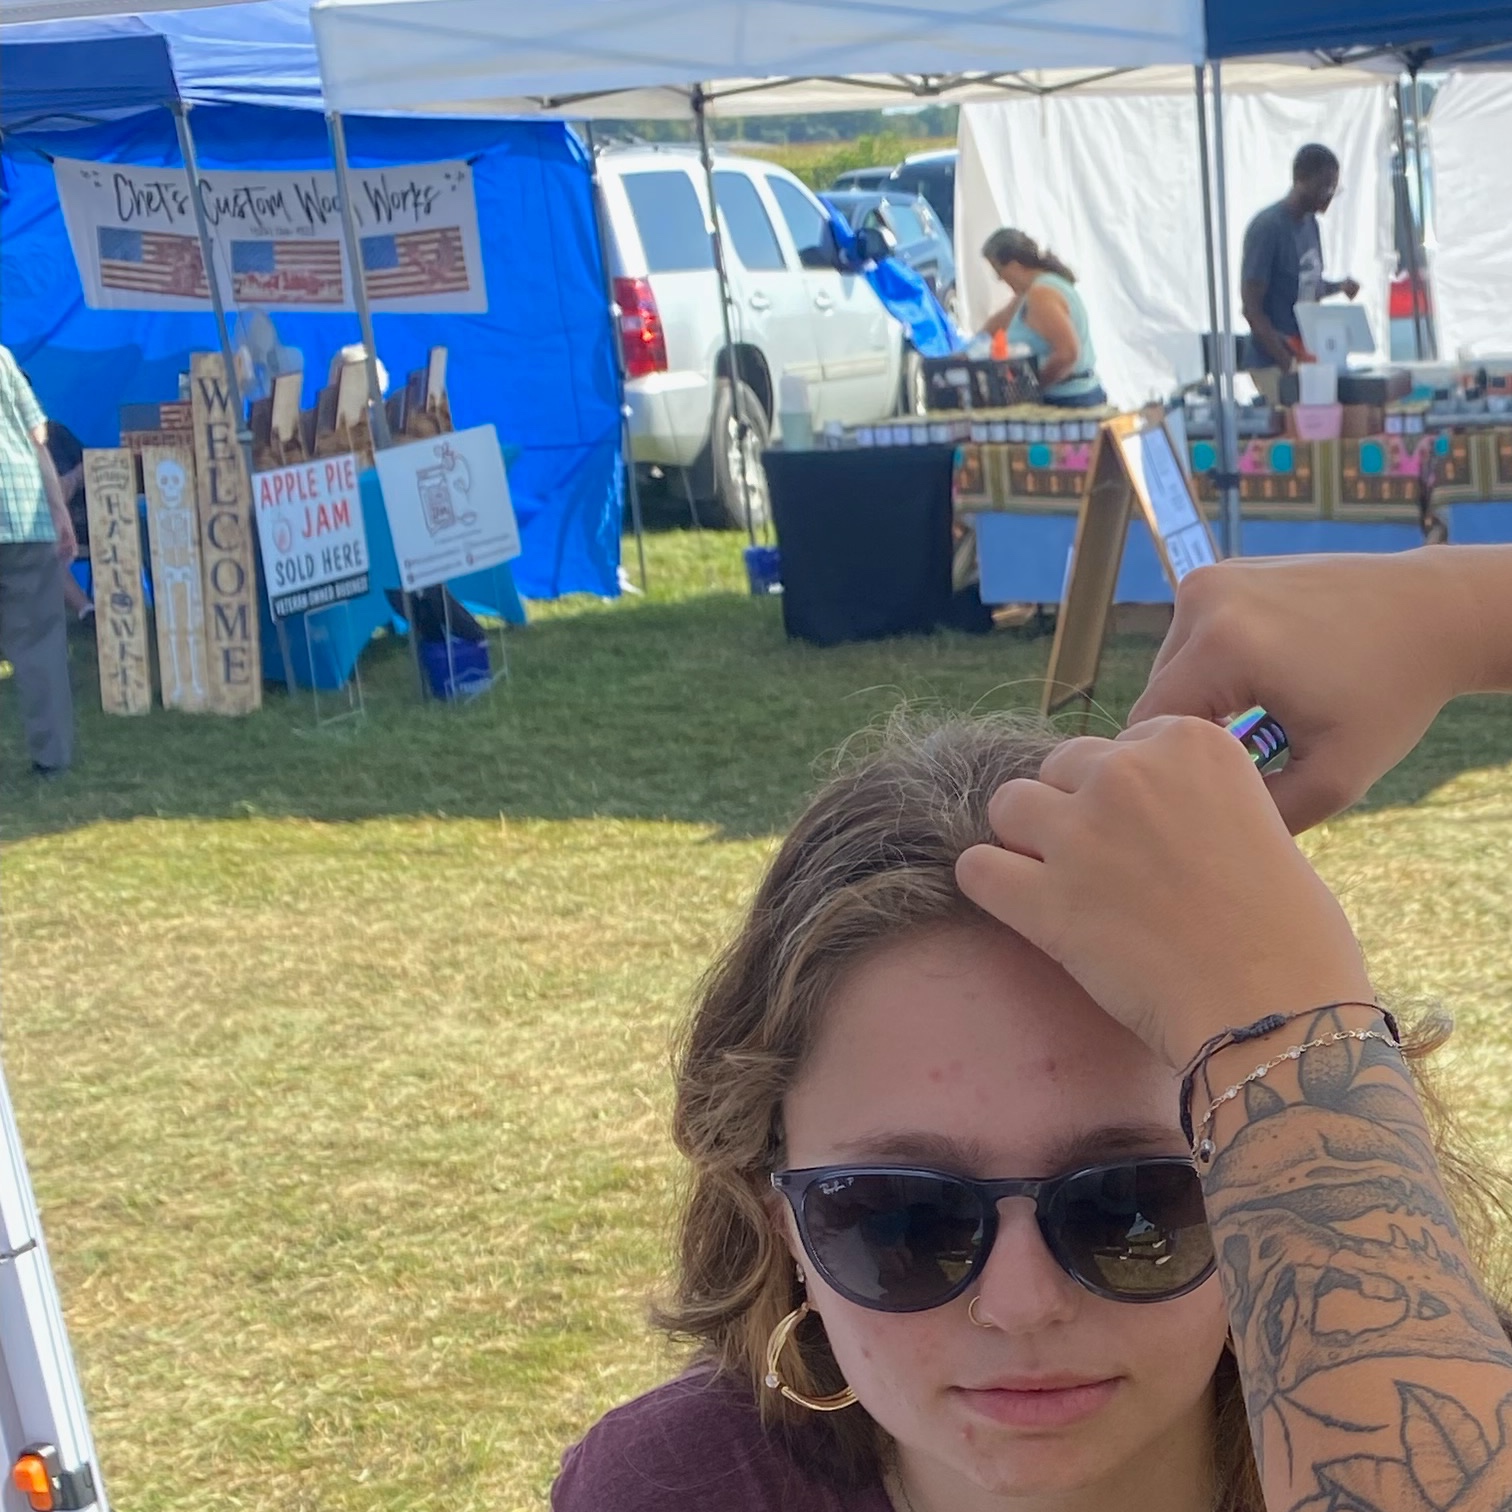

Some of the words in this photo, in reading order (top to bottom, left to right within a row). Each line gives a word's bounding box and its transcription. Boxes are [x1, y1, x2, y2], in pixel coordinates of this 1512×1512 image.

[199, 179, 292, 227] Custom
[294, 176, 363, 228] Woo
[363, 173, 441, 225] Works
[260, 468, 318, 511] APPLE
[325, 459, 355, 494] PIE
[198, 376, 252, 686] WELCOME
[302, 498, 351, 538] JAM
[275, 553, 315, 587] SOLD
[321, 540, 362, 575] HERE
